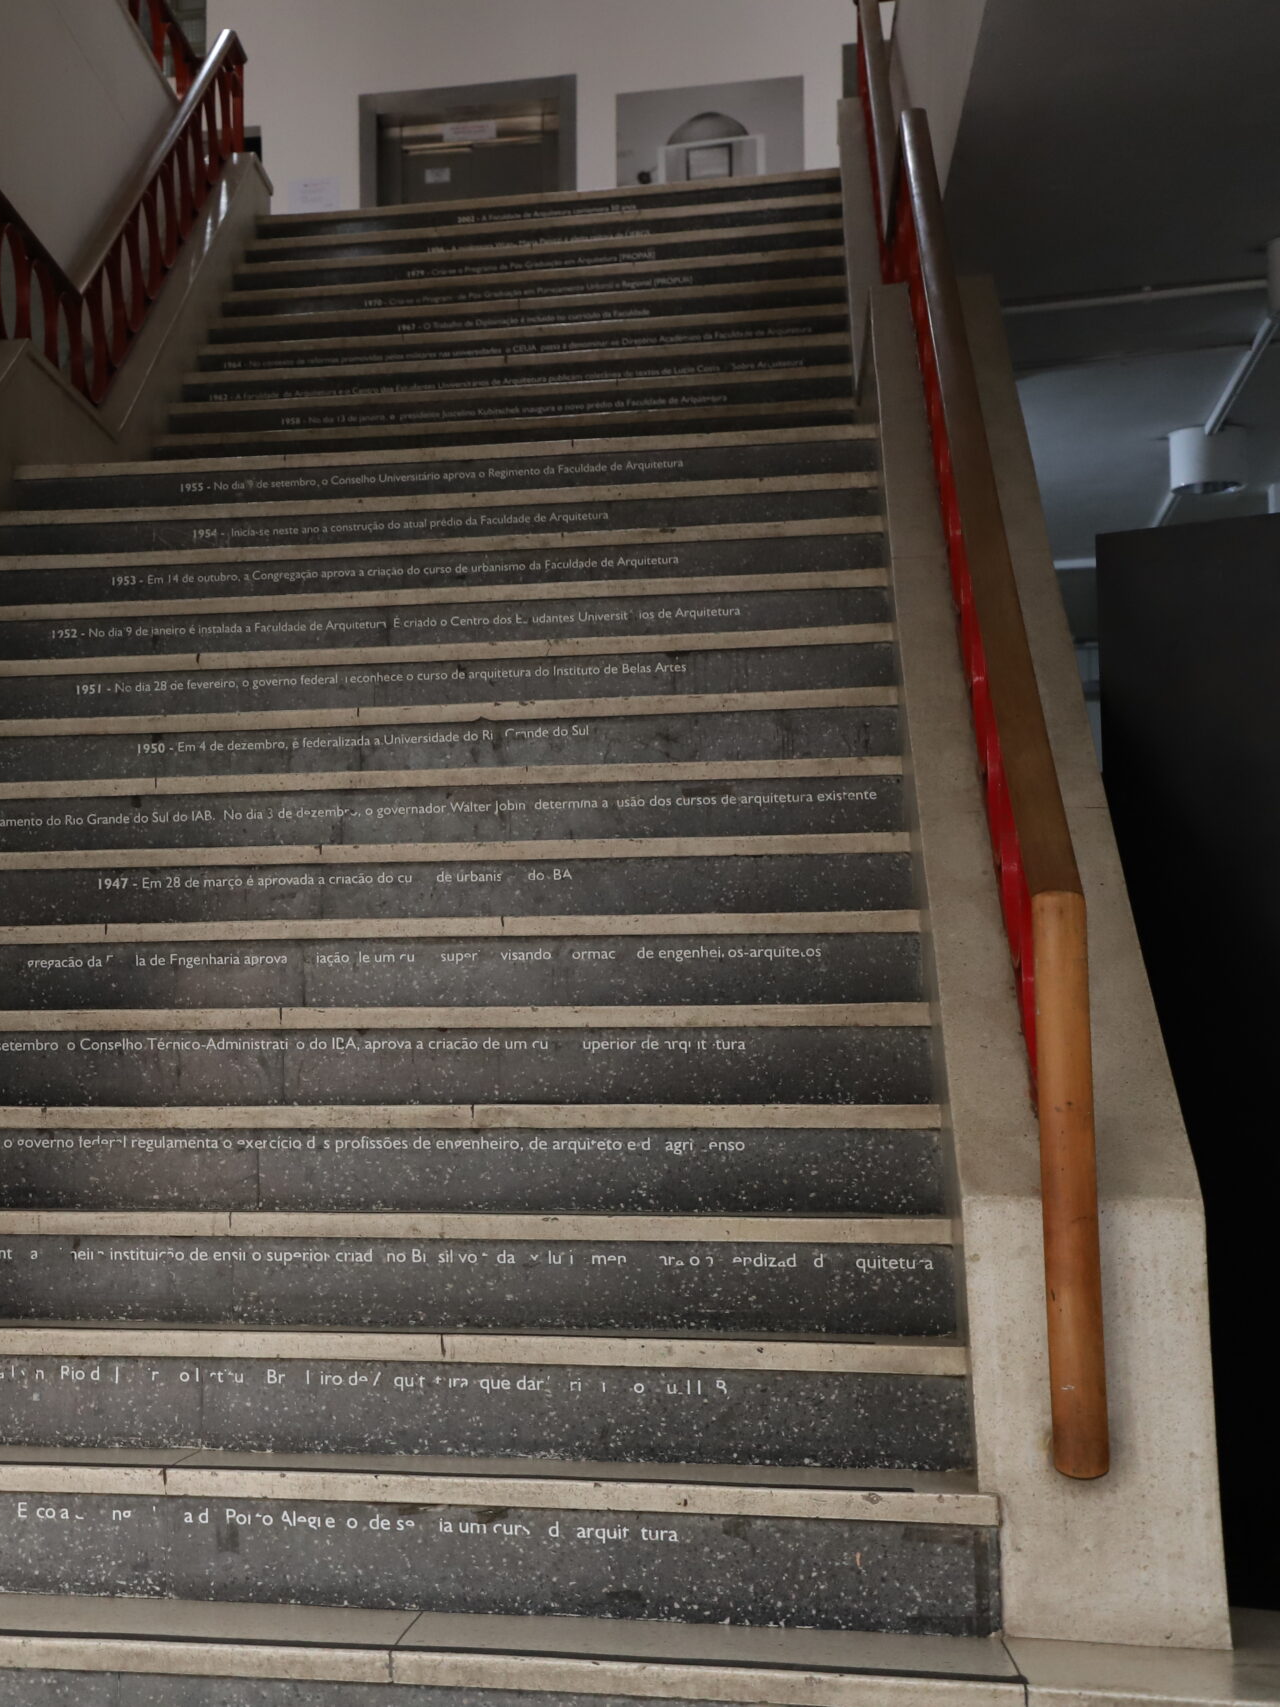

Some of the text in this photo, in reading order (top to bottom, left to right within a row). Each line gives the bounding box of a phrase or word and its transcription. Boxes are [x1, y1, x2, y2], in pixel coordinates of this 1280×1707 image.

[280, 417, 301, 425] 1958
[180, 482, 204, 492] 1955
[212, 481, 229, 490] No
[230, 480, 245, 490] dia
[330, 474, 377, 485] Conselho
[378, 473, 441, 483] Universitário
[442, 471, 476, 482] aprova
[488, 467, 541, 480] Regimento
[557, 462, 608, 474] Faculdade
[625, 460, 684, 472] Arquitetura
[192, 512, 609, 539] 1954 Inicia-se neste ano construção do atual prédio Faculdade Arquitetura
[111, 556, 679, 586] 1953 Em outubro, Congregação aprova criação curso urbanismo Faculdade Arquitetura
[51, 628, 78, 639] 1952
[88, 627, 106, 638] No
[107, 627, 122, 637] dia
[150, 625, 187, 636] janeiro
[198, 623, 243, 634] instalada
[402, 616, 438, 628] criado
[449, 615, 490, 627] Centro
[492, 614, 513, 625] dos
[674, 607, 741, 620] Arquitetura
[76, 683, 102, 695] 1951
[114, 682, 132, 693] No
[134, 681, 151, 692] dia
[153, 680, 168, 691] 28
[186, 679, 239, 690] fevereiro,
[251, 678, 298, 690] governo
[299, 673, 338, 685] federal
[416, 672, 448, 681] curso
[468, 667, 532, 681] arquitetura
[534, 666, 550, 677] do
[552, 665, 601, 676] Instituto
[621, 662, 652, 674] Belas
[654, 661, 687, 673] Artes
[136, 724, 589, 755] 1950 Em de dezembro, federalizada Universidade do do Sul
[45, 815, 62, 826] do
[64, 814, 84, 826] Rio
[86, 813, 131, 825] Grande
[132, 812, 149, 824] do
[151, 811, 169, 823] Sul
[190, 809, 216, 822] IAB.
[222, 809, 243, 820] No
[245, 808, 263, 820] dia
[376, 802, 447, 819] governador
[449, 801, 492, 813] Walter
[493, 799, 526, 815] Jobin
[534, 799, 598, 810] determina
[648, 794, 672, 807] dos
[674, 796, 717, 806] cursos
[720, 794, 737, 805] de
[738, 792, 814, 807] arquitetura
[816, 790, 878, 802] existente
[97, 871, 394, 890] 1947 Em 28 de março aprovada do
[86, 955, 103, 968] da
[243, 955, 288, 966] aprova
[374, 954, 396, 963] um
[500, 947, 552, 961] visando
[636, 946, 655, 959] de
[79, 1037, 143, 1051] Conselho
[308, 1037, 328, 1050] do
[364, 1040, 413, 1053] aprova
[482, 1036, 501, 1050] de
[504, 1040, 528, 1050] um
[130, 1135, 219, 1152] regulamenta
[334, 1135, 409, 1153] profissões
[412, 1135, 432, 1150] de
[435, 1136, 524, 1152] engenheiro,
[528, 1136, 548, 1150] de
[188, 1247, 209, 1261] de
[386, 1252, 407, 1263] no
[478, 1378, 511, 1394] que
